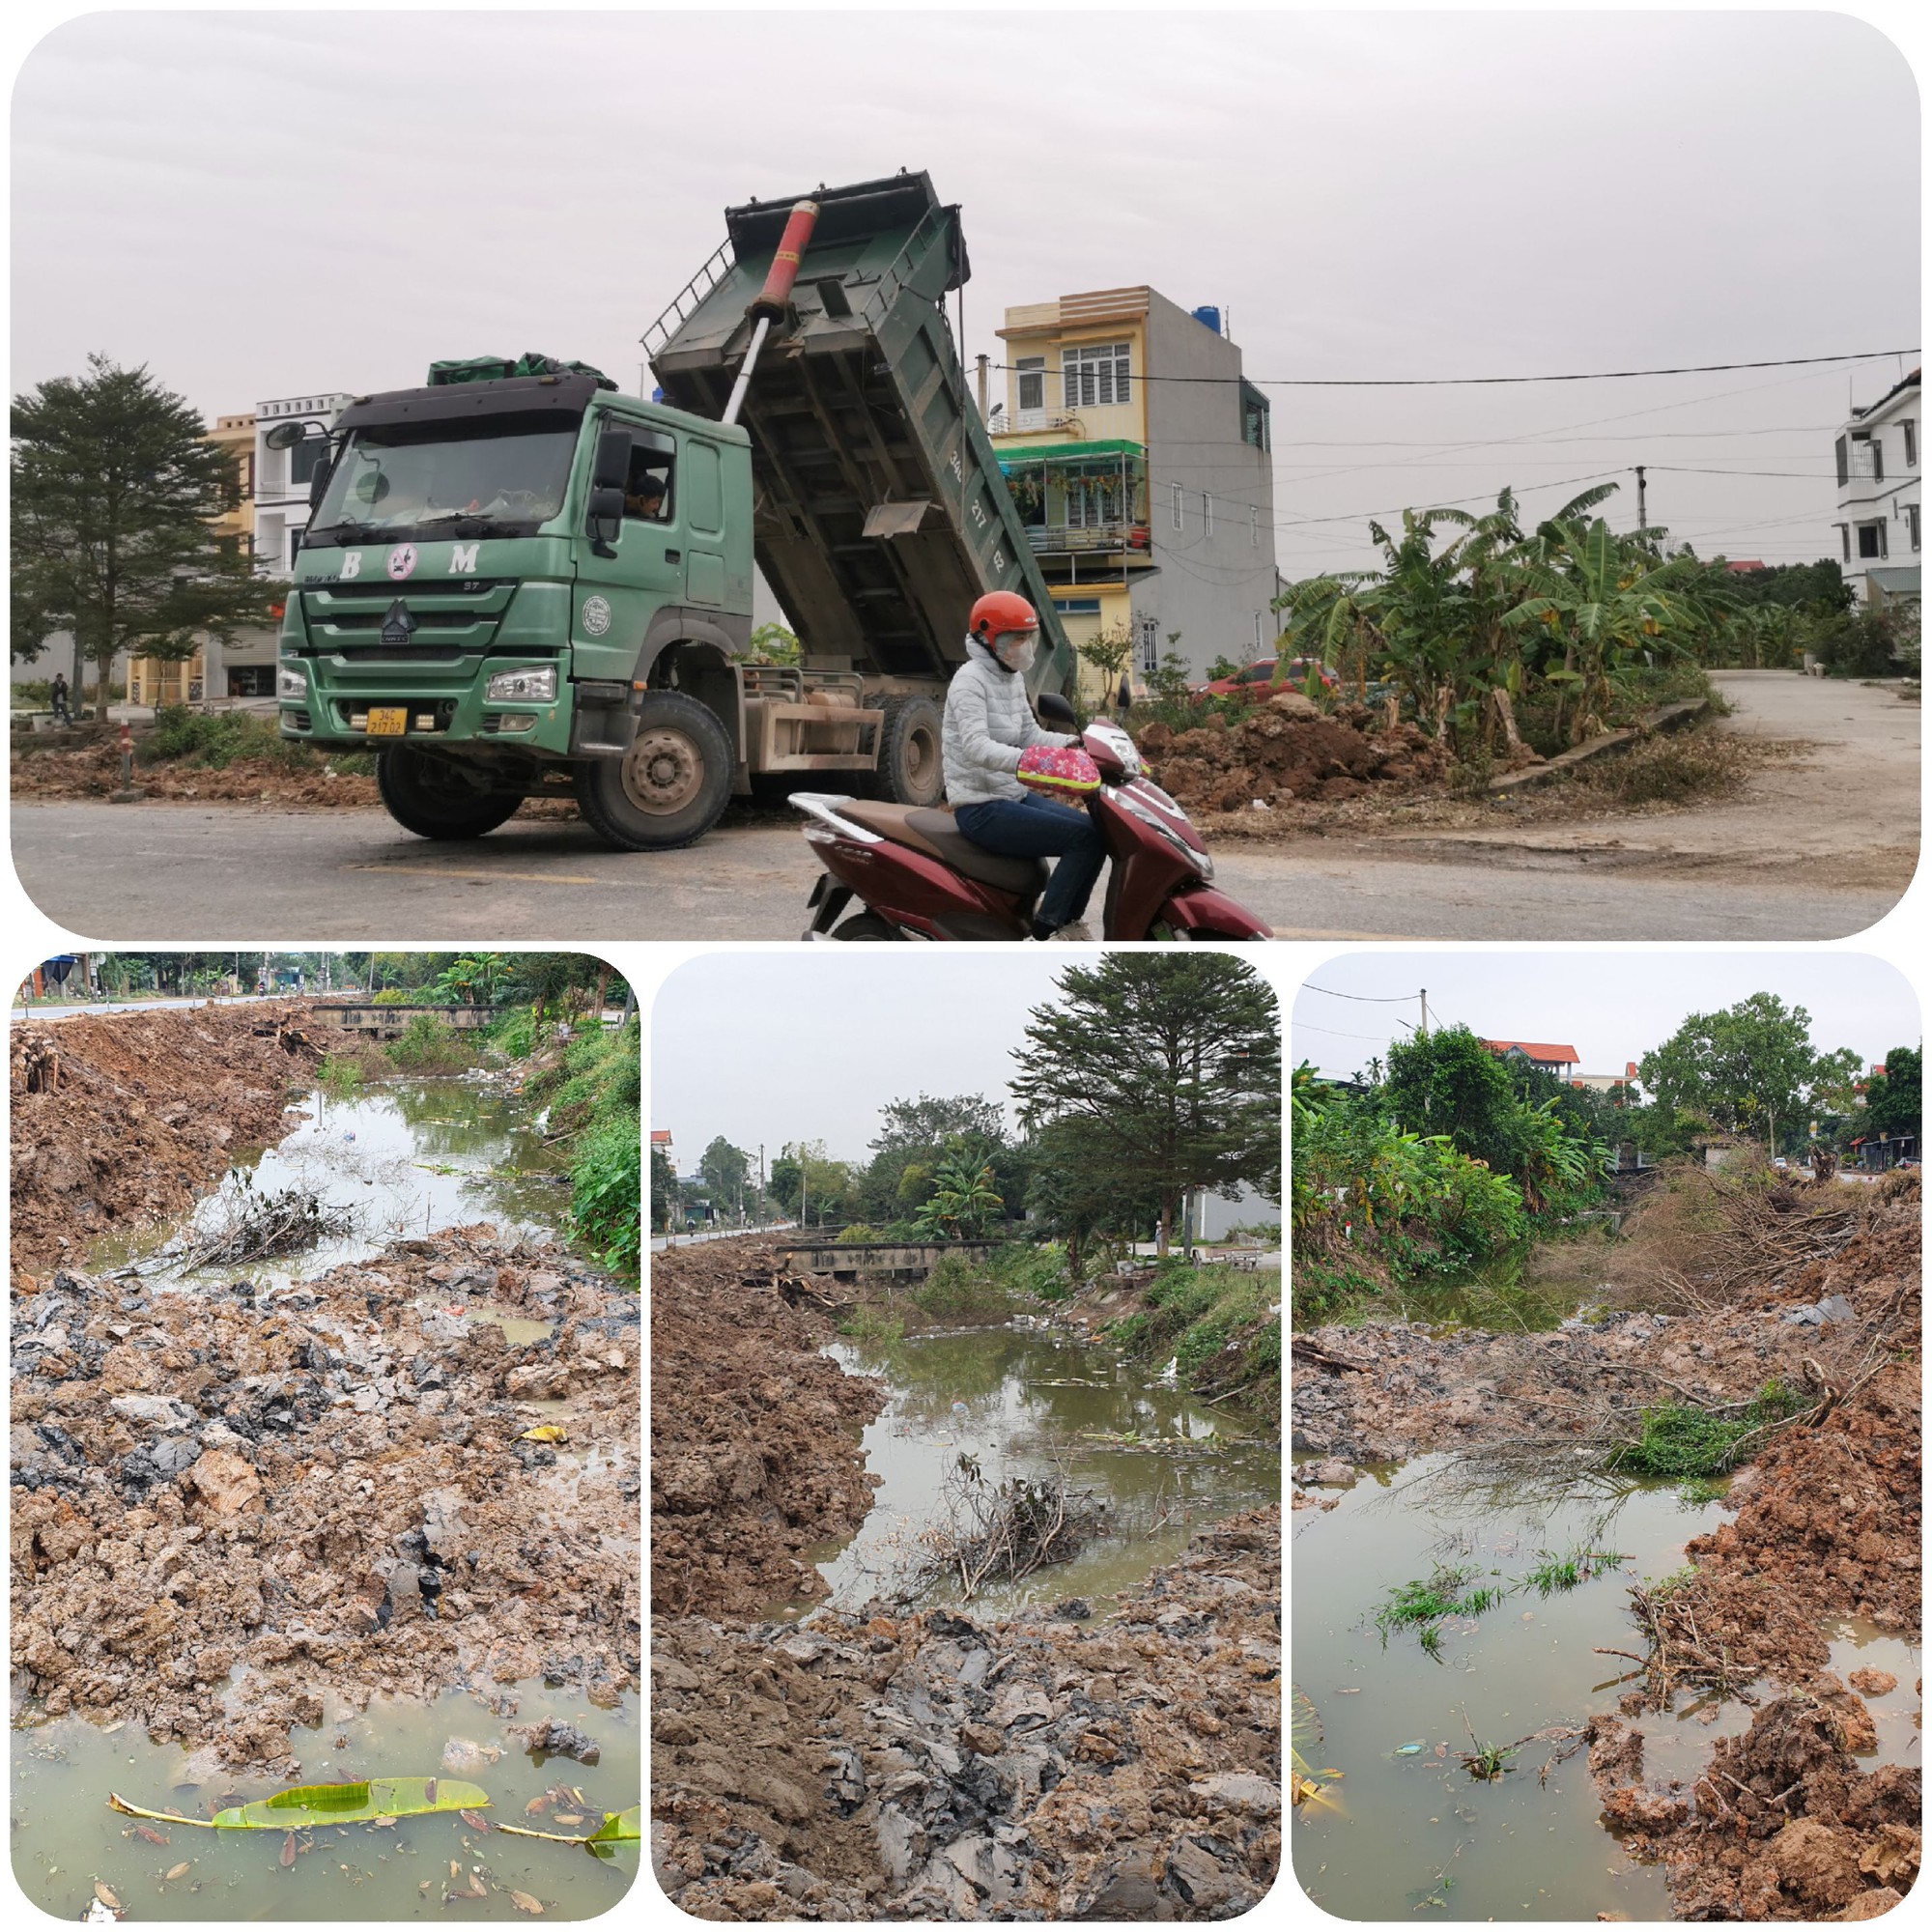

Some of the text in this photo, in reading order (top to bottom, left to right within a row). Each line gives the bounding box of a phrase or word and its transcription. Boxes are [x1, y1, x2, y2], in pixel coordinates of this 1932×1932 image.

[971, 498, 987, 528] 217
[340, 544, 480, 579] B M
[379, 709, 396, 721] 34C
